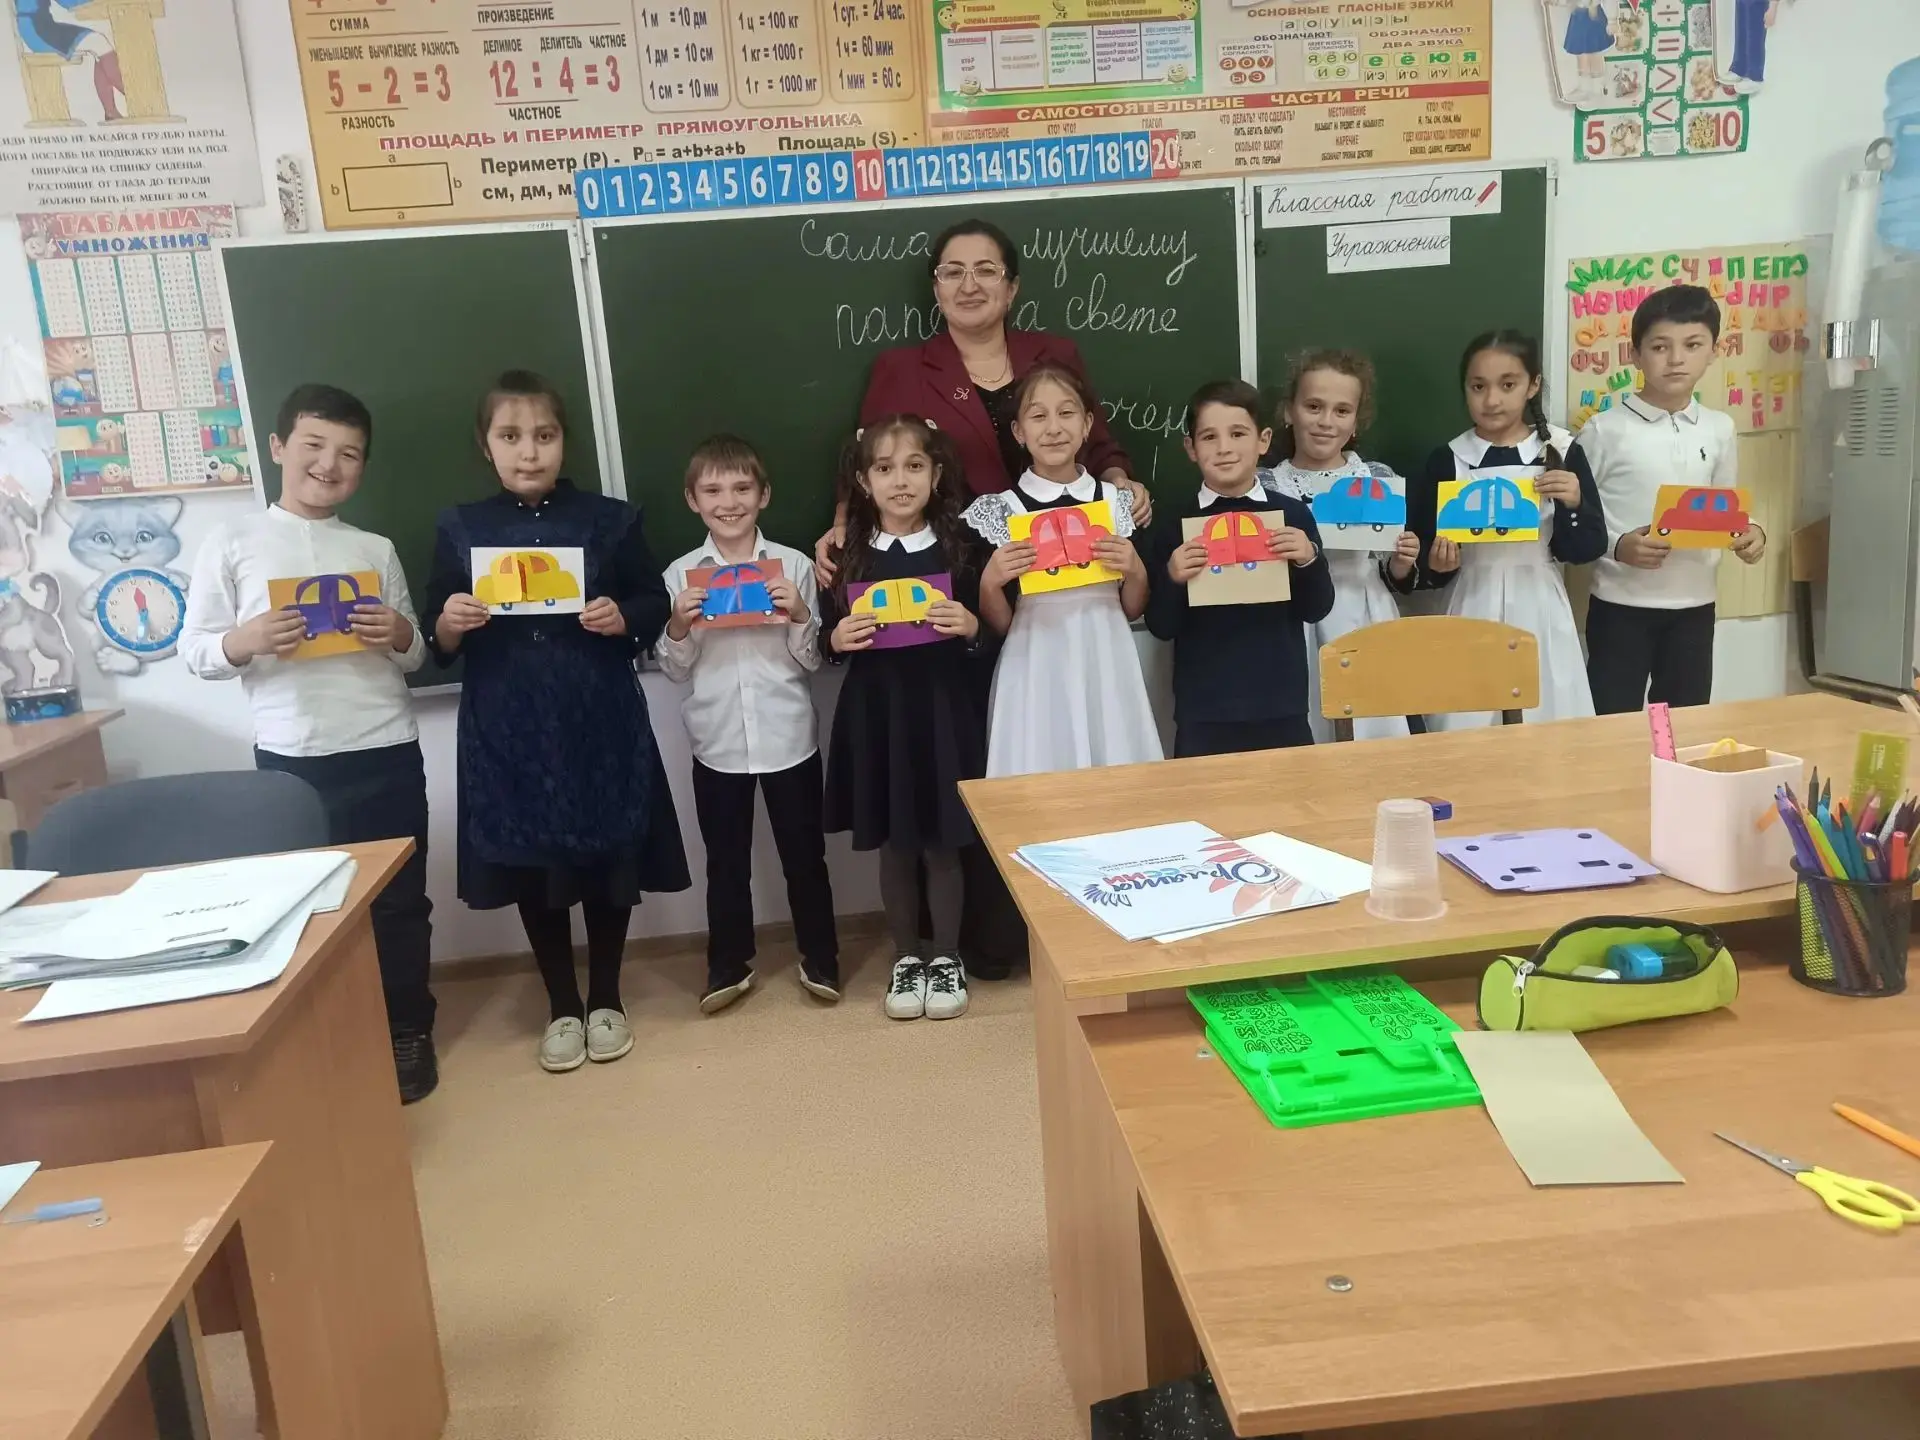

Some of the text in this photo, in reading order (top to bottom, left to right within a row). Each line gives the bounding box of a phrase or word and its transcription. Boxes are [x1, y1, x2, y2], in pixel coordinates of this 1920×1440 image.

[477, 8, 554, 24] ПРОИЗВЕДЕНИЕ
[641, 8, 647, 28] 1
[693, 11, 707, 29] дм
[841, 6, 858, 27] сут.
[873, 0, 884, 20] 24
[1248, 0, 1454, 18] ОСНОВНЫЕ ГЛАСНЫЕ ЗВУКИ
[329, 17, 370, 31] СУММА
[738, 12, 744, 30] 1
[789, 15, 799, 29] кг
[1254, 31, 1332, 42] ОБОЗНАЧАЮТ
[1369, 26, 1472, 38] ОБОЗНАЧАЮТ
[309, 41, 460, 62] УМЕНЬШАЕМОЕ ВЫЧИТАЕМОЕ РАЗНОСТЬ
[483, 34, 627, 56] ДЕЛИМОЕ ДЕЛИТЕЛЬ ЧАСТНОЕ
[742, 44, 748, 62] 1
[751, 48, 760, 62] кг
[772, 43, 796, 61] 1000
[862, 35, 873, 57] 60
[876, 40, 893, 56] мин
[1382, 38, 1464, 50] ДВА ЗВУКА
[646, 43, 714, 67] 1 дм 10 см
[328, 63, 451, 107] 5 2 3
[489, 55, 621, 98] 12 4 3
[746, 76, 751, 95] 1
[779, 74, 803, 93] 1000
[805, 78, 817, 91] мг
[847, 73, 865, 89] мин
[882, 66, 893, 88] 60
[649, 78, 719, 100] 1 см 10 мм
[509, 106, 562, 121] ЧАСТНОЕ
[1016, 86, 1410, 121] САМОСТОЯТЕЛЬНЫЕ ЧАСТИ РЕЧИ
[341, 115, 395, 130] РАЗНОСТЬ
[379, 112, 863, 151] ПЛОЩАДЬ И ПЕРИМЕТР ПРЯМОУГОЛЬНИКА
[1714, 111, 1741, 147] 10
[0, 136, 25, 145] ИДИ
[778, 131, 897, 150] Площадь (S)
[1586, 121, 1606, 155] 5
[480, 154, 577, 175] Периметр
[582, 136, 1179, 210] 0 1 2 3 4 5 6 7 8 9 10 11 12 13 14 15 16 17 18 19 20
[482, 184, 552, 202] см, дм,
[1268, 177, 1476, 216] Классная работа
[57, 208, 202, 236] ТАБЛИЦА
[56, 233, 209, 254] УМНОЖЕНИЯ
[1327, 233, 1449, 266] Упражнение
[1024, 227, 1197, 288] лучшему
[1012, 301, 1046, 331] а
[1066, 273, 1180, 333] свете
